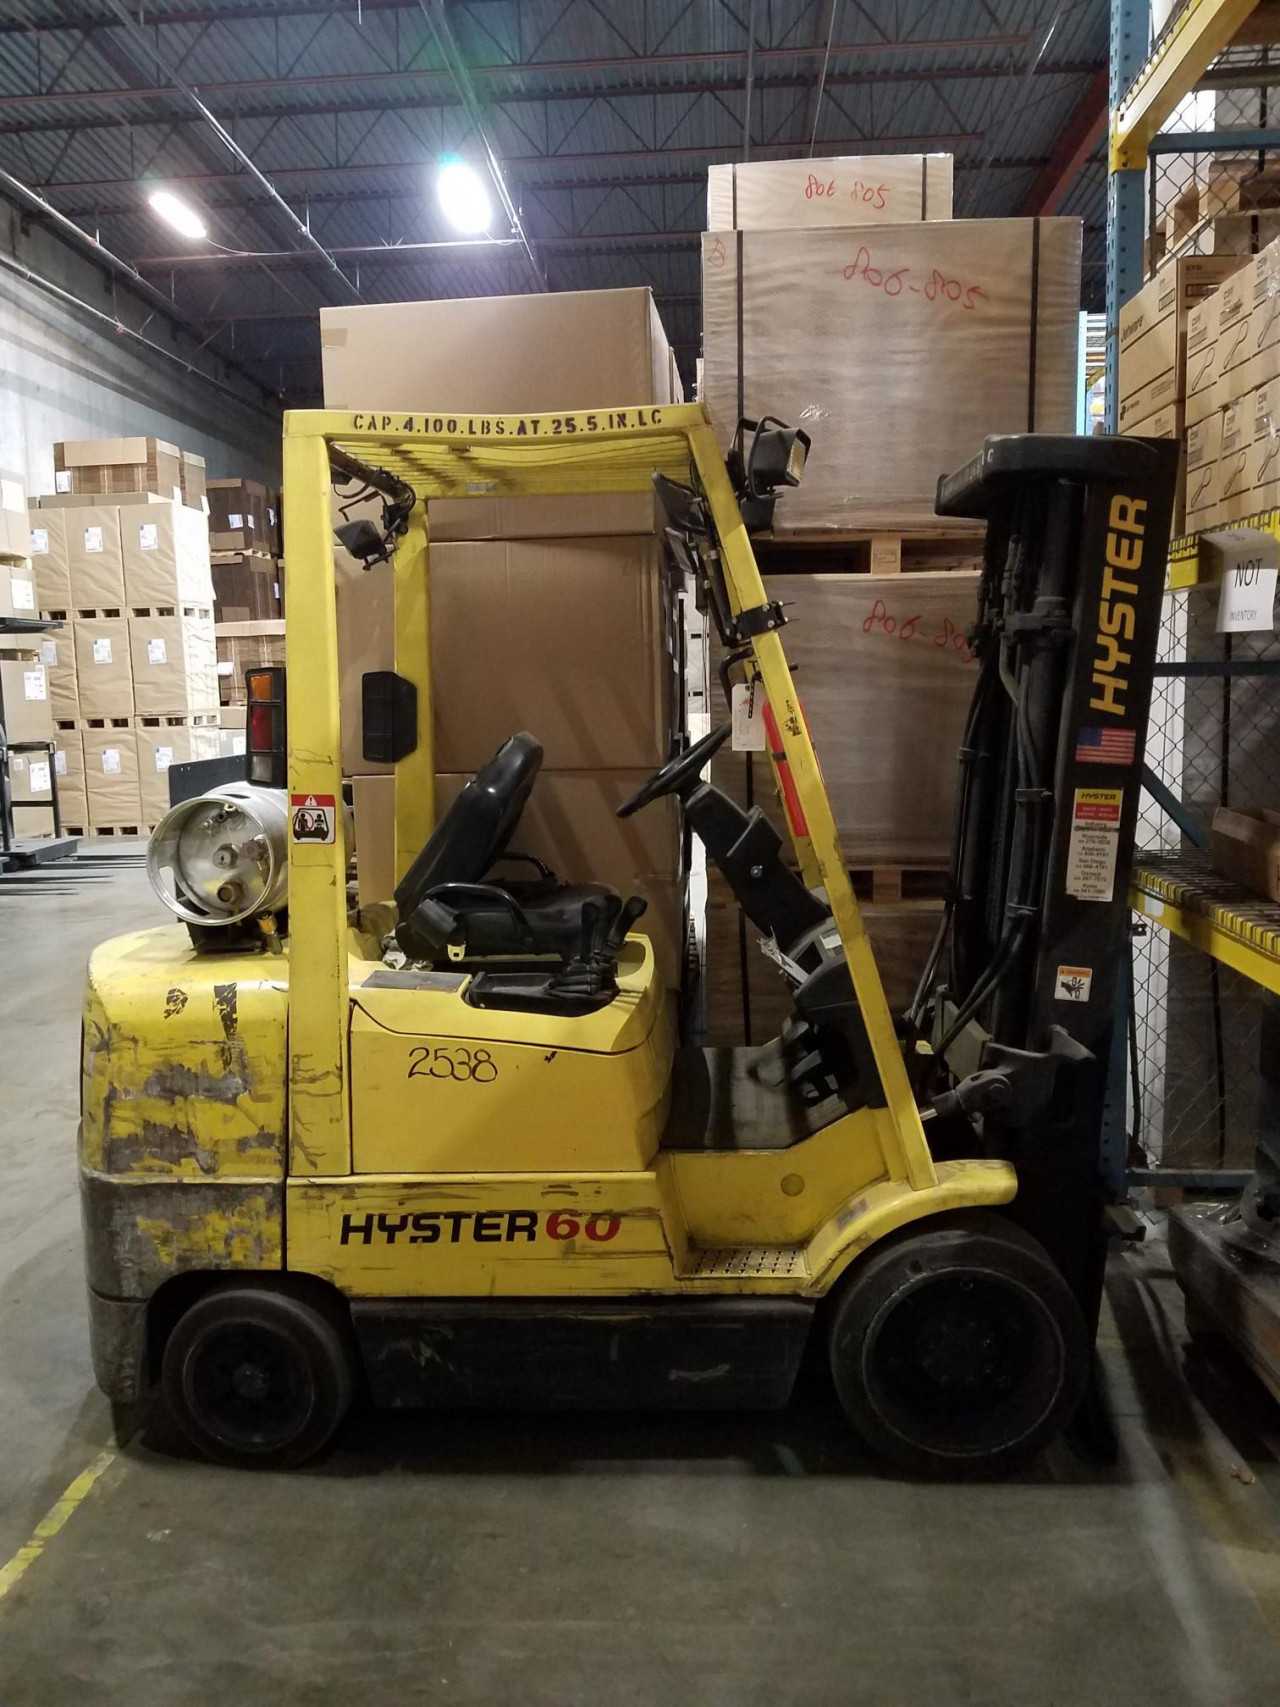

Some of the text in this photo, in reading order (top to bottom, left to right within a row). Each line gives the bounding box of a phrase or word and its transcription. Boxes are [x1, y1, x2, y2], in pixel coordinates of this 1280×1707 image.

[1234, 558, 1263, 589] NOT
[1089, 494, 1148, 716] HYSTER
[408, 1047, 498, 1083] 2538
[340, 1208, 623, 1245] HYSTER 60
